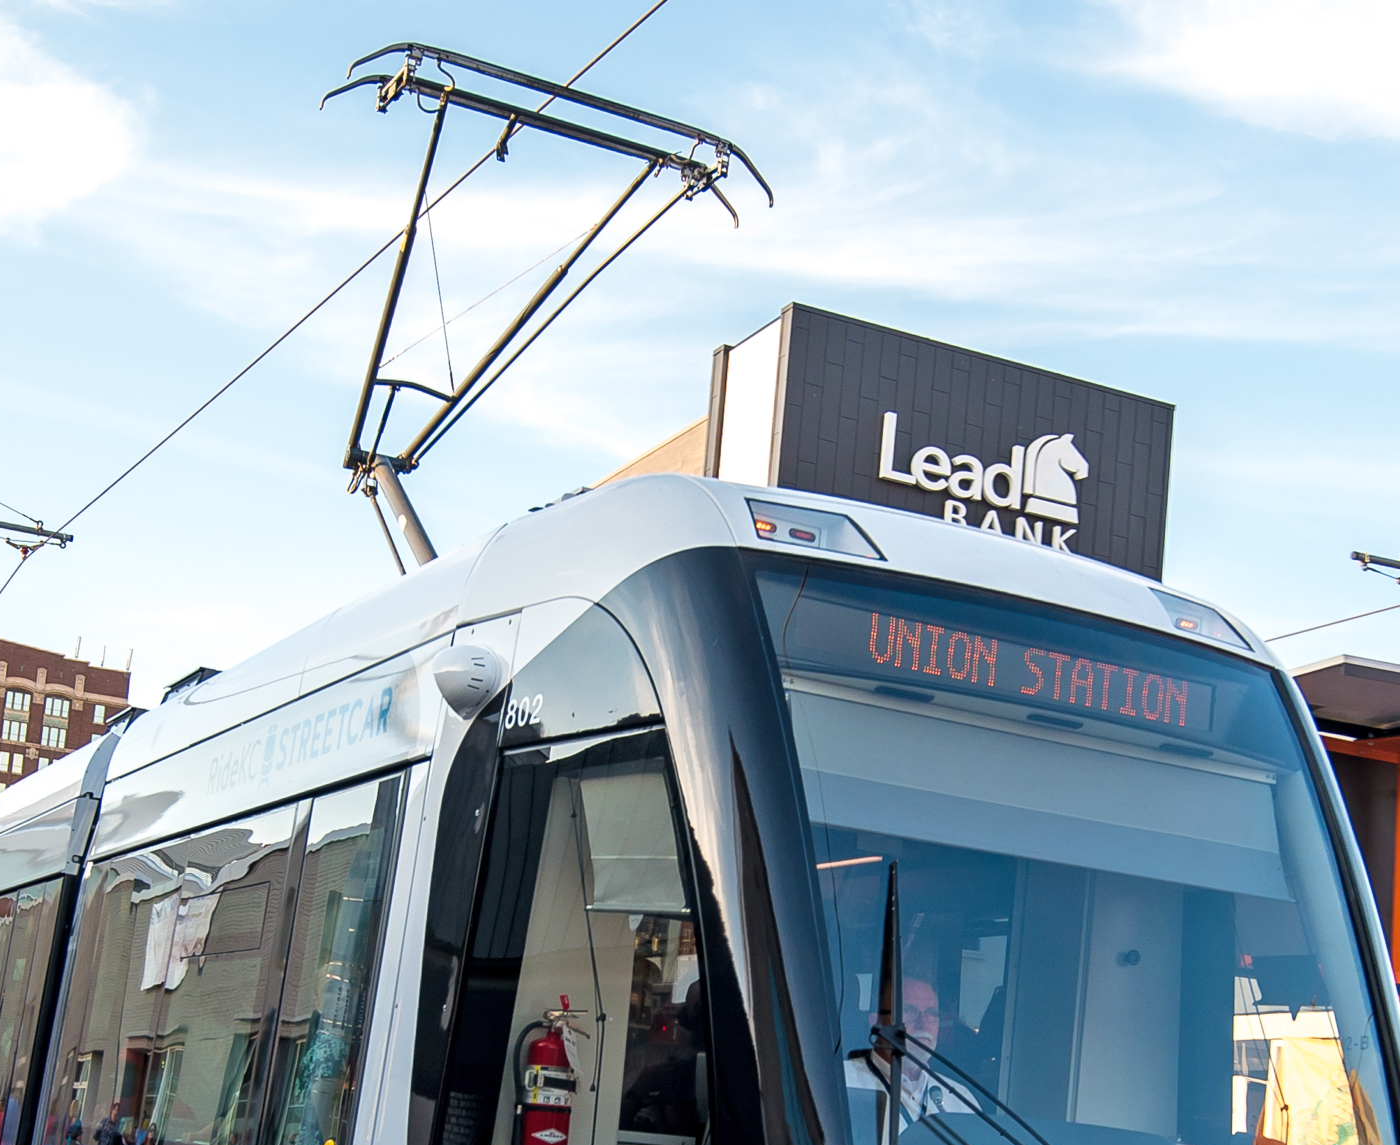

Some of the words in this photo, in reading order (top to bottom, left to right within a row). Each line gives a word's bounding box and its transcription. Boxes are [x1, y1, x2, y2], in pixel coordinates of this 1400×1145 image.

[879, 411, 1025, 510] Lead
[944, 499, 1078, 553] BANK
[505, 693, 544, 730] 802
[869, 613, 998, 687] UNION
[1020, 647, 1188, 727] STATION
[206, 739, 262, 796] RideKC
[275, 686, 393, 773] STREETCAR
